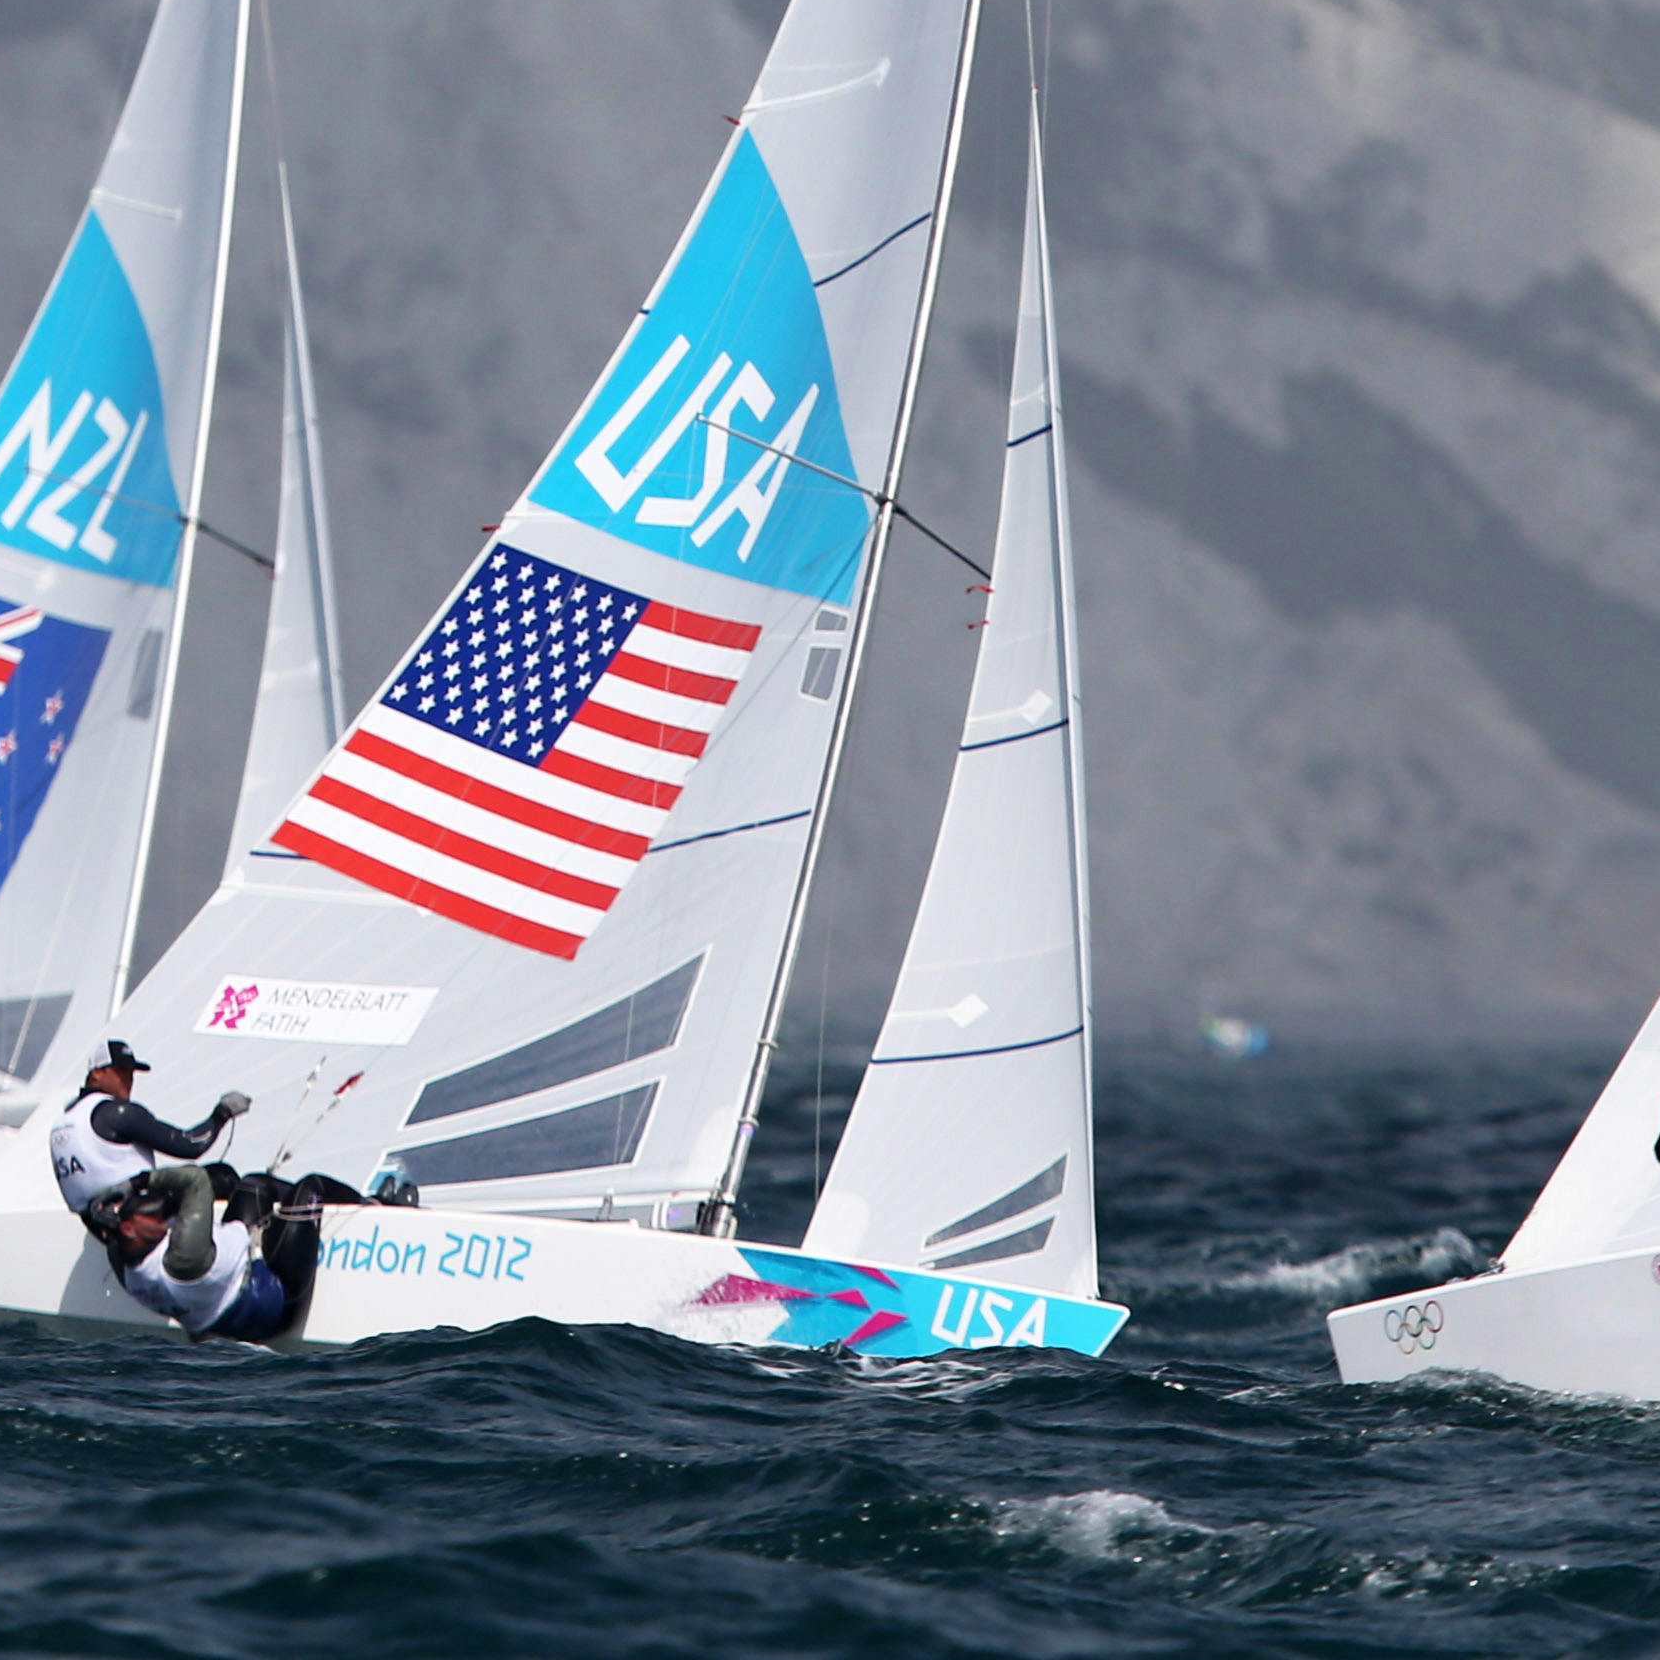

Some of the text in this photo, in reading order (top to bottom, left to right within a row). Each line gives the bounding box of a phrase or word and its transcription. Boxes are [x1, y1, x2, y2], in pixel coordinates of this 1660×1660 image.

[574, 333, 820, 563] USA
[266, 987, 410, 1012] MENDELBLATT
[316, 1224, 532, 1282] ndon 2012
[930, 1283, 1048, 1348] USA
